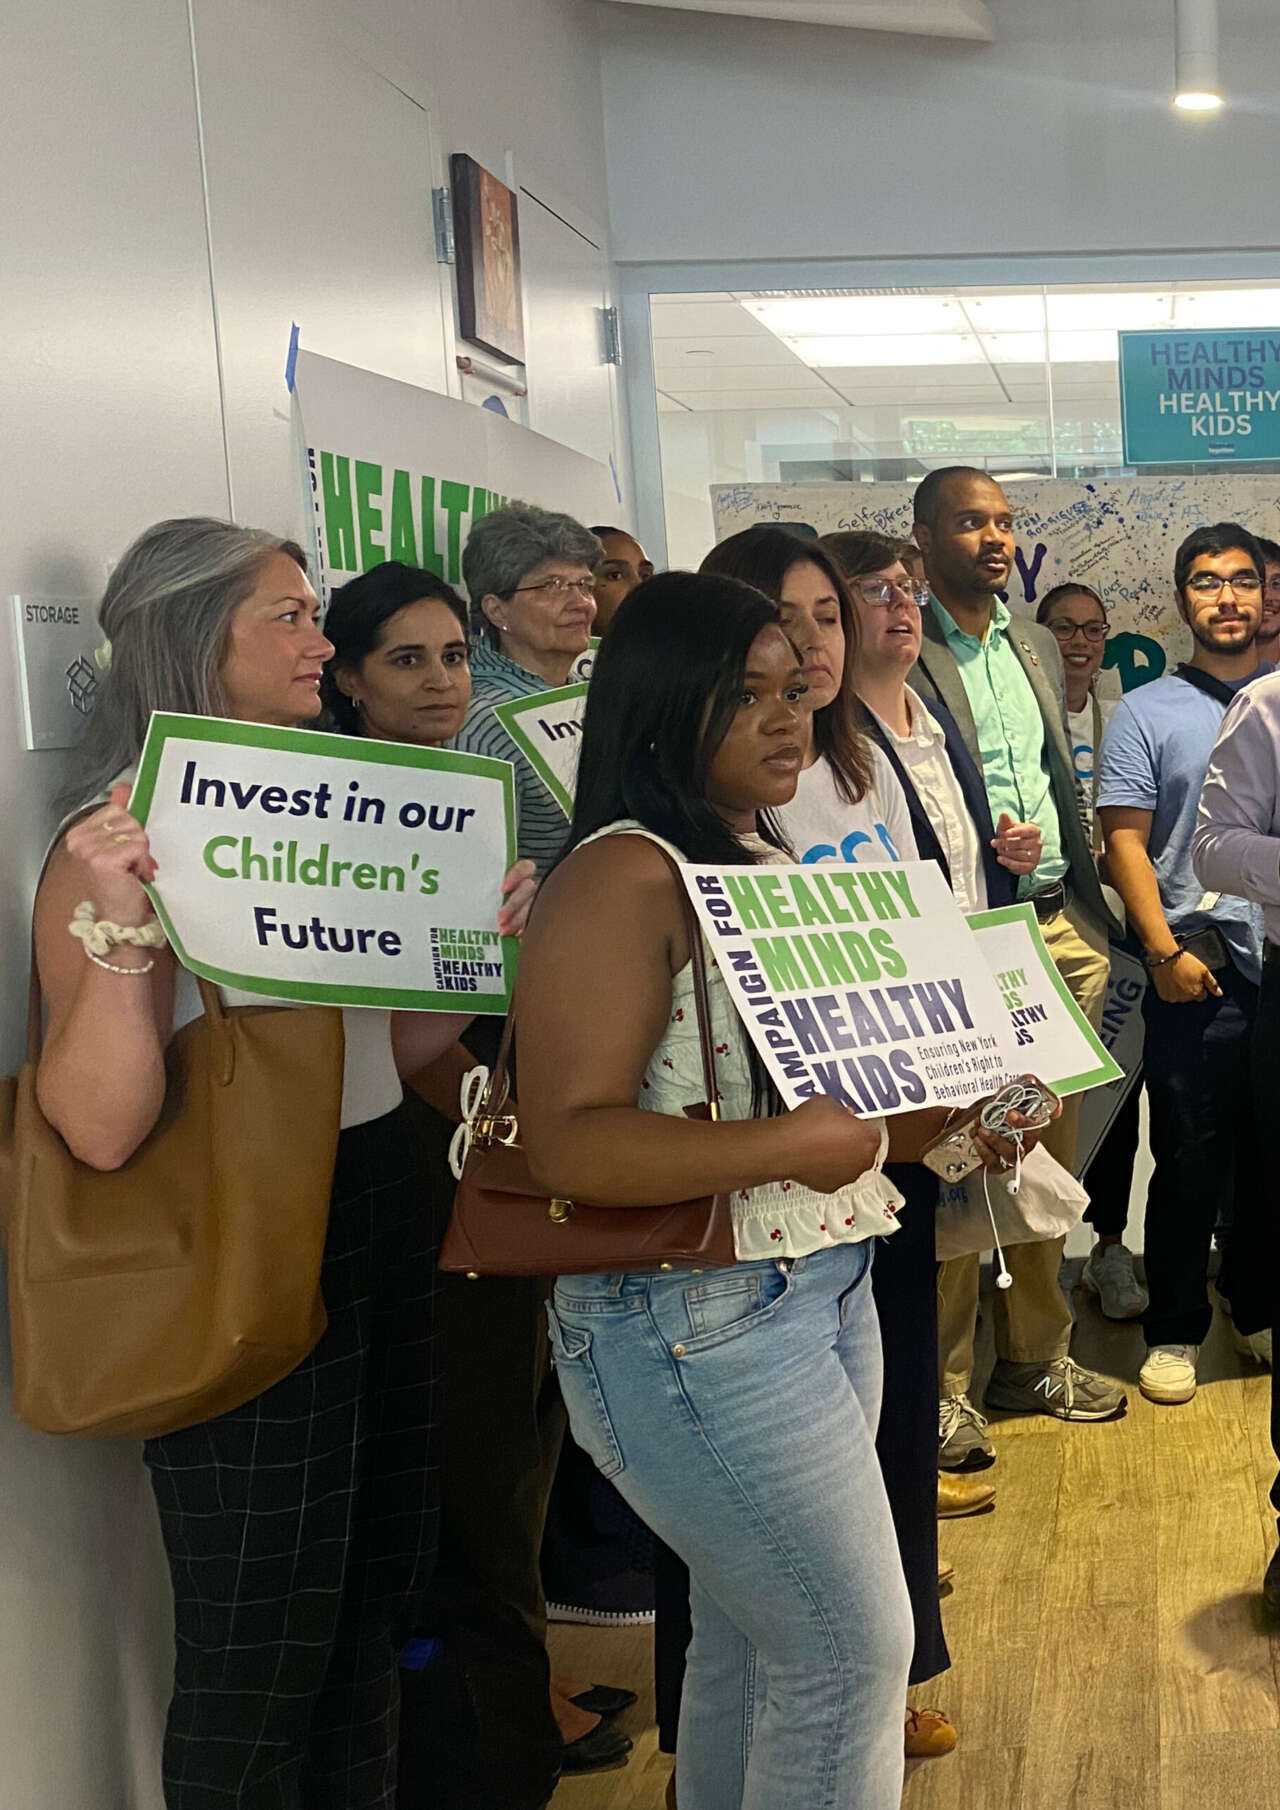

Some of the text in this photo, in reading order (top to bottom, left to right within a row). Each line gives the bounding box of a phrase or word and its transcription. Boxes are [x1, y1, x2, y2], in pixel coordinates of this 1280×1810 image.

[1168, 366, 1265, 391] MINDS
[1160, 390, 1280, 414] HEALTHY
[1192, 414, 1252, 437] KIDS
[320, 451, 507, 584] HEALT
[26, 605, 79, 624] STORAGE
[180, 761, 476, 833] Invest in our
[203, 835, 440, 895] Children's
[696, 875, 743, 936] FOR
[723, 871, 921, 930] HEALTHY
[254, 906, 402, 956] Future
[439, 928, 500, 945] HEALTHY
[440, 945, 485, 960] MINDS
[750, 928, 908, 992] MINDS
[442, 960, 503, 977] HEALTHY
[444, 976, 477, 991] KIDS
[727, 951, 818, 1099] AMPAIGN
[780, 979, 975, 1053] HEALTHY
[1011, 1004, 1048, 1028] LTHY
[917, 1034, 998, 1060] Ensuring New York
[925, 1055, 1004, 1080] Children's Right to
[812, 1049, 928, 1115] KIDS
[933, 1079, 980, 1100] Behavioral
[979, 1074, 1003, 1091] Health
